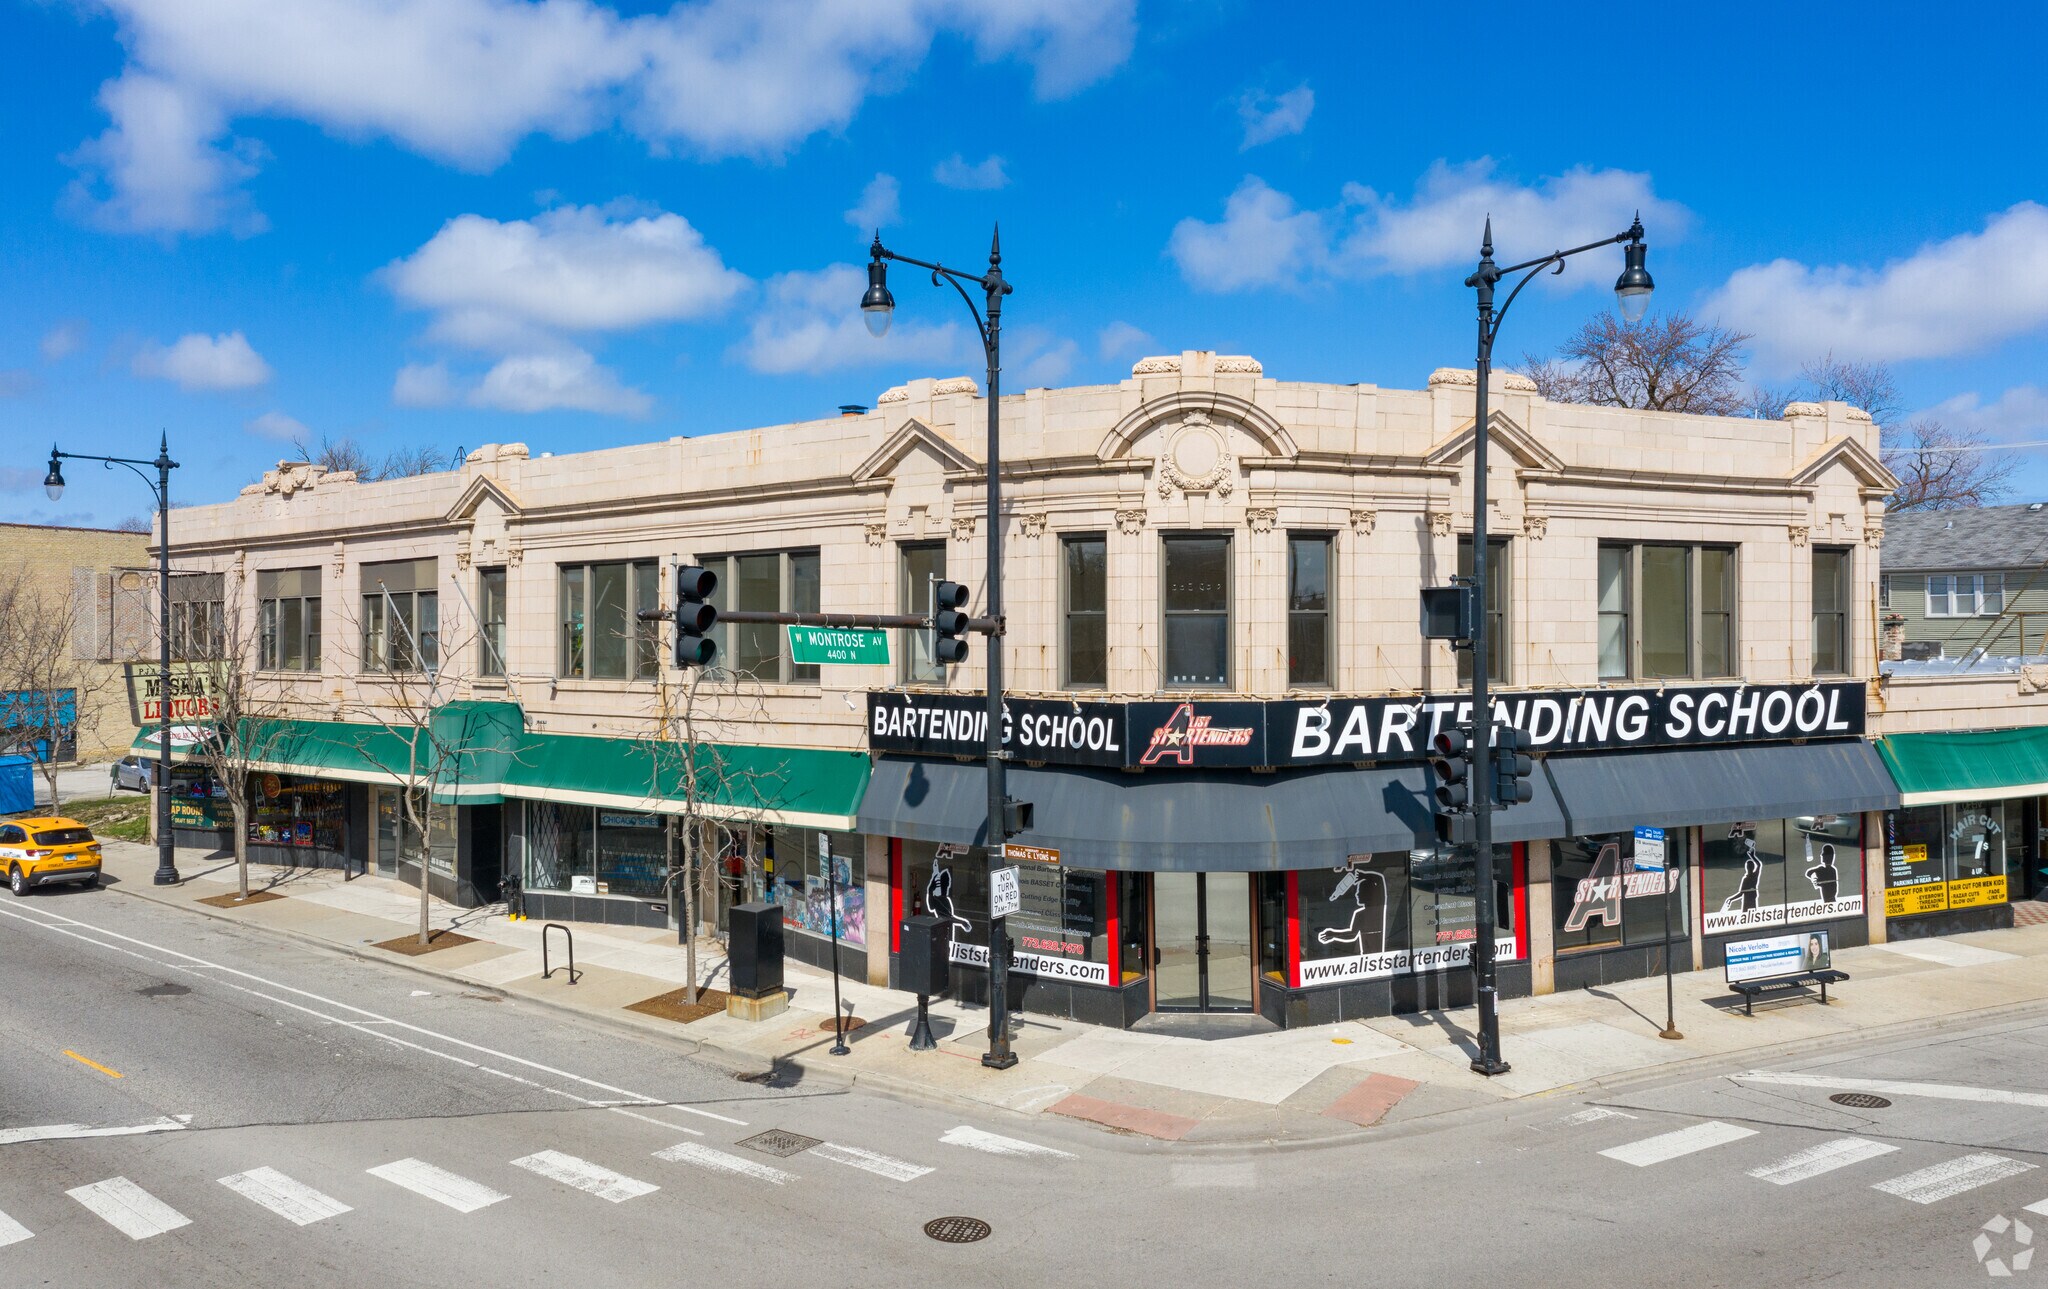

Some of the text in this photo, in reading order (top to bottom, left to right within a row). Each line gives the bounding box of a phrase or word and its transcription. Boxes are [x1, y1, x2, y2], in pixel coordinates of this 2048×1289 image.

[795, 632, 882, 647] W MONTROSE AV
[827, 650, 856, 659] 4400 N
[145, 675, 220, 697] MSKA'S
[1665, 689, 1851, 737] SCHOOL
[1019, 713, 1119, 752] SCHOOL
[170, 805, 181, 815] AP
[602, 815, 636, 825] CHICAGO
[1949, 814, 2002, 840] HAIR CUT
[1007, 849, 1026, 858] THOMAS
[1033, 852, 1049, 861] LYONS
[1000, 872, 1010, 883] NO
[1030, 880, 1054, 888] BASSET
[1893, 878, 1914, 887] PARKING
[997, 882, 1014, 893] TURN
[1887, 884, 1943, 897] HAIR CUT FOR WOMEN
[1950, 883, 1961, 891] HAIR
[1982, 879, 1993, 887] MEN
[1993, 878, 2005, 886] KIDS
[994, 890, 1017, 904] ON RED
[1043, 896, 1058, 904] Edge
[1919, 898, 1944, 906] THREADING
[994, 902, 1018, 914] 7AM-7PM
[1706, 901, 1861, 929] www.aliststartenders.com
[1437, 928, 1477, 941] 773.628.7
[1022, 936, 1085, 955] 773.628.7470
[1728, 945, 1746, 953] Nicole
[951, 943, 1105, 981] liststenders.com
[1304, 942, 1512, 981] www.aliststartenderm
